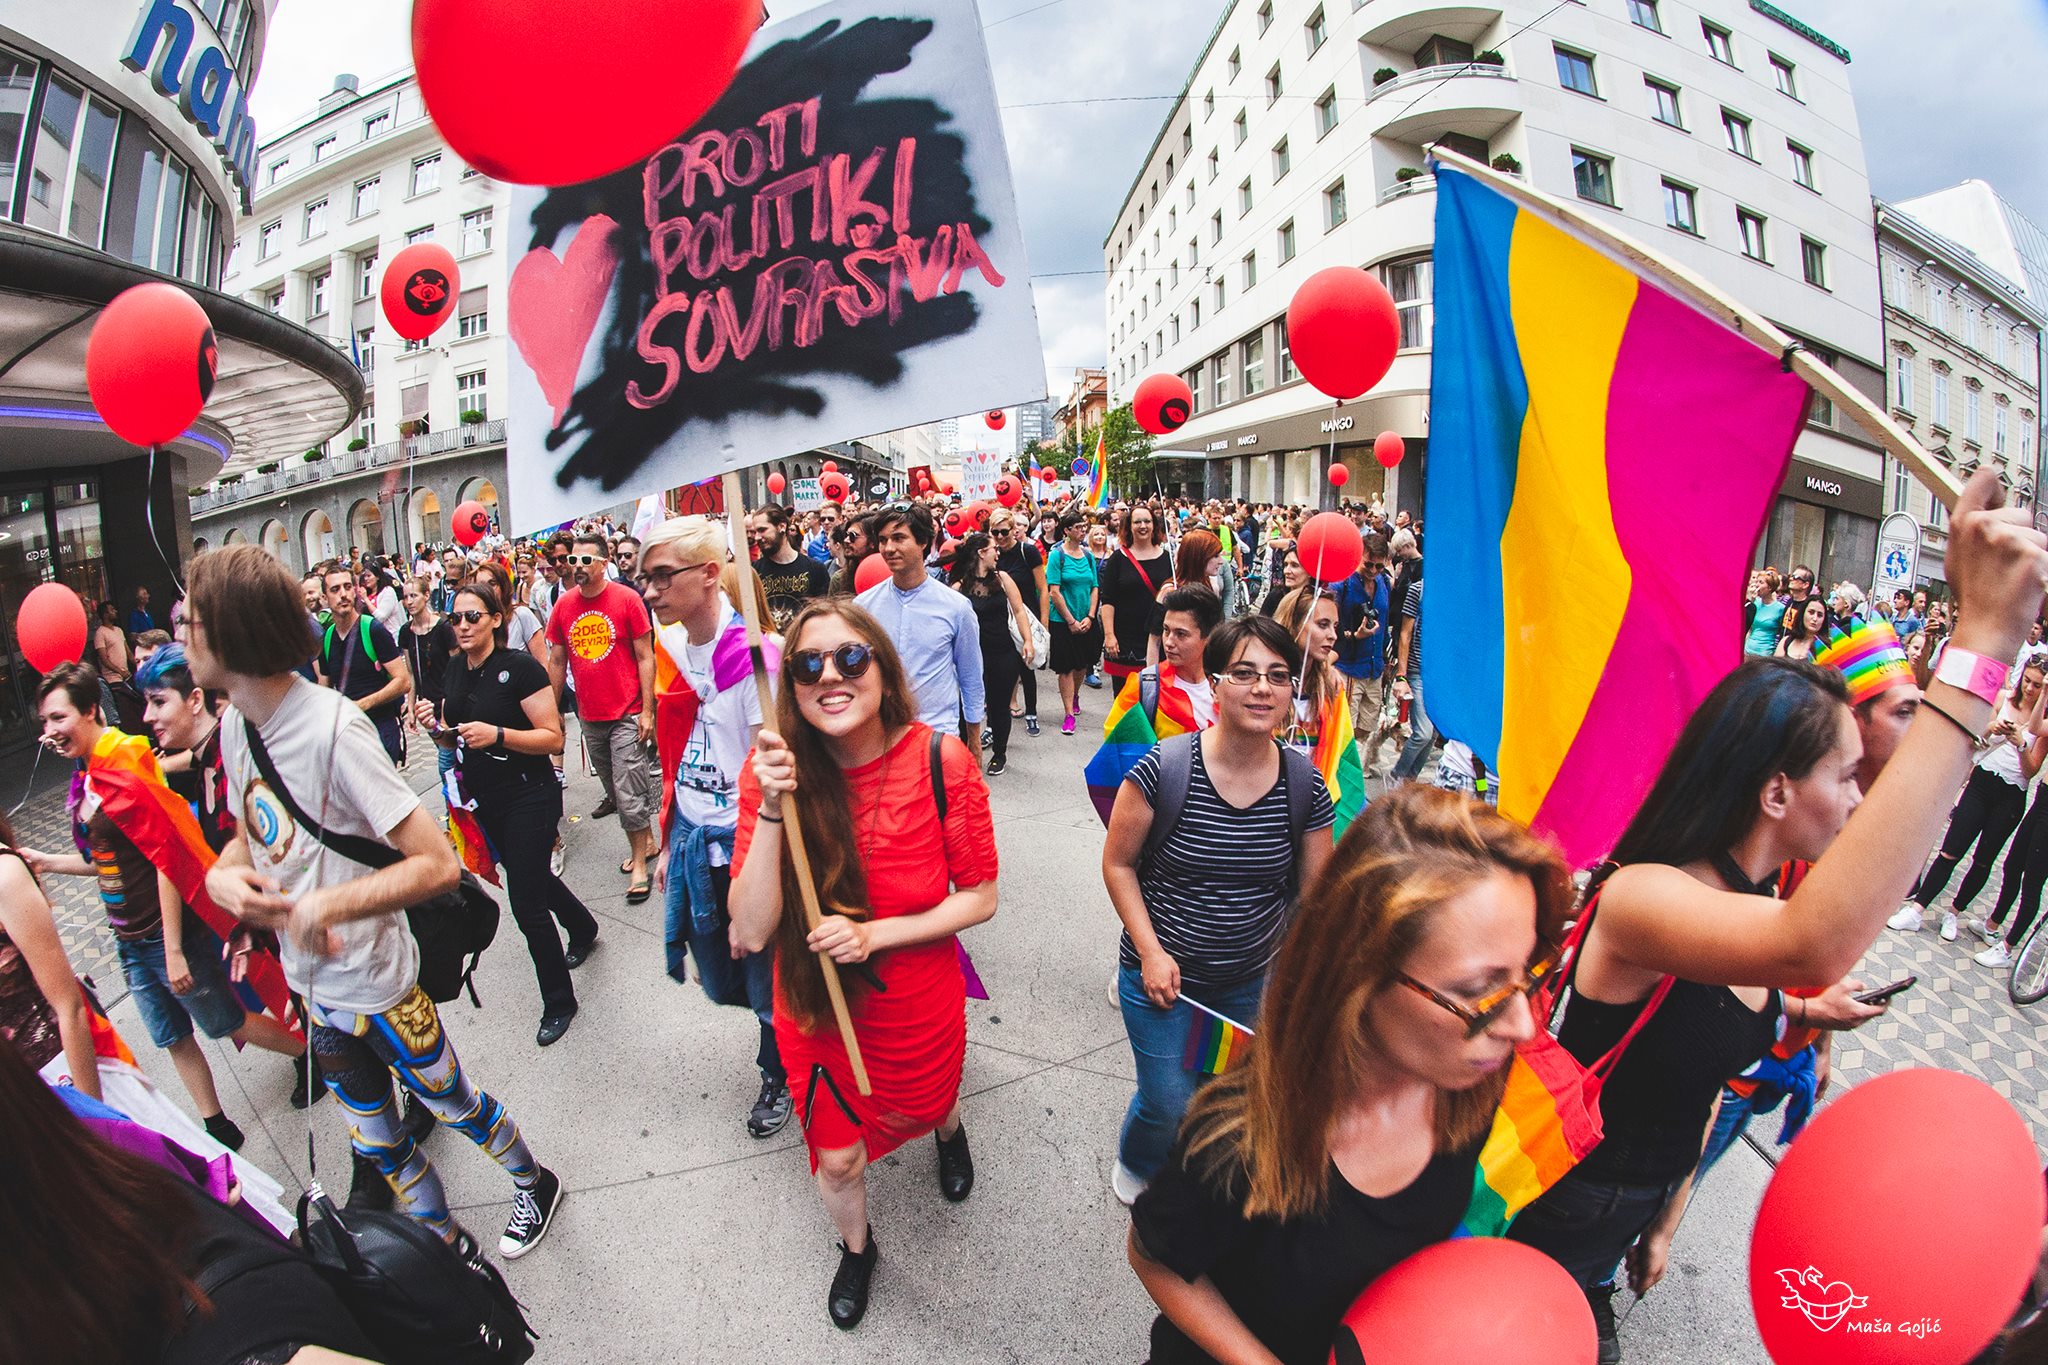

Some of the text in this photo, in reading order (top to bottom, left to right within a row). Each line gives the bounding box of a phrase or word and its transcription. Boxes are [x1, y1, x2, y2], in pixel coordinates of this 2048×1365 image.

[643, 95, 821, 232] PROTI
[1321, 416, 1354, 432] MANGO
[1237, 434, 1258, 446] MANGO
[793, 480, 816, 489] SOME
[1806, 476, 1841, 496] MANGO
[795, 492, 819, 500] MARRY
